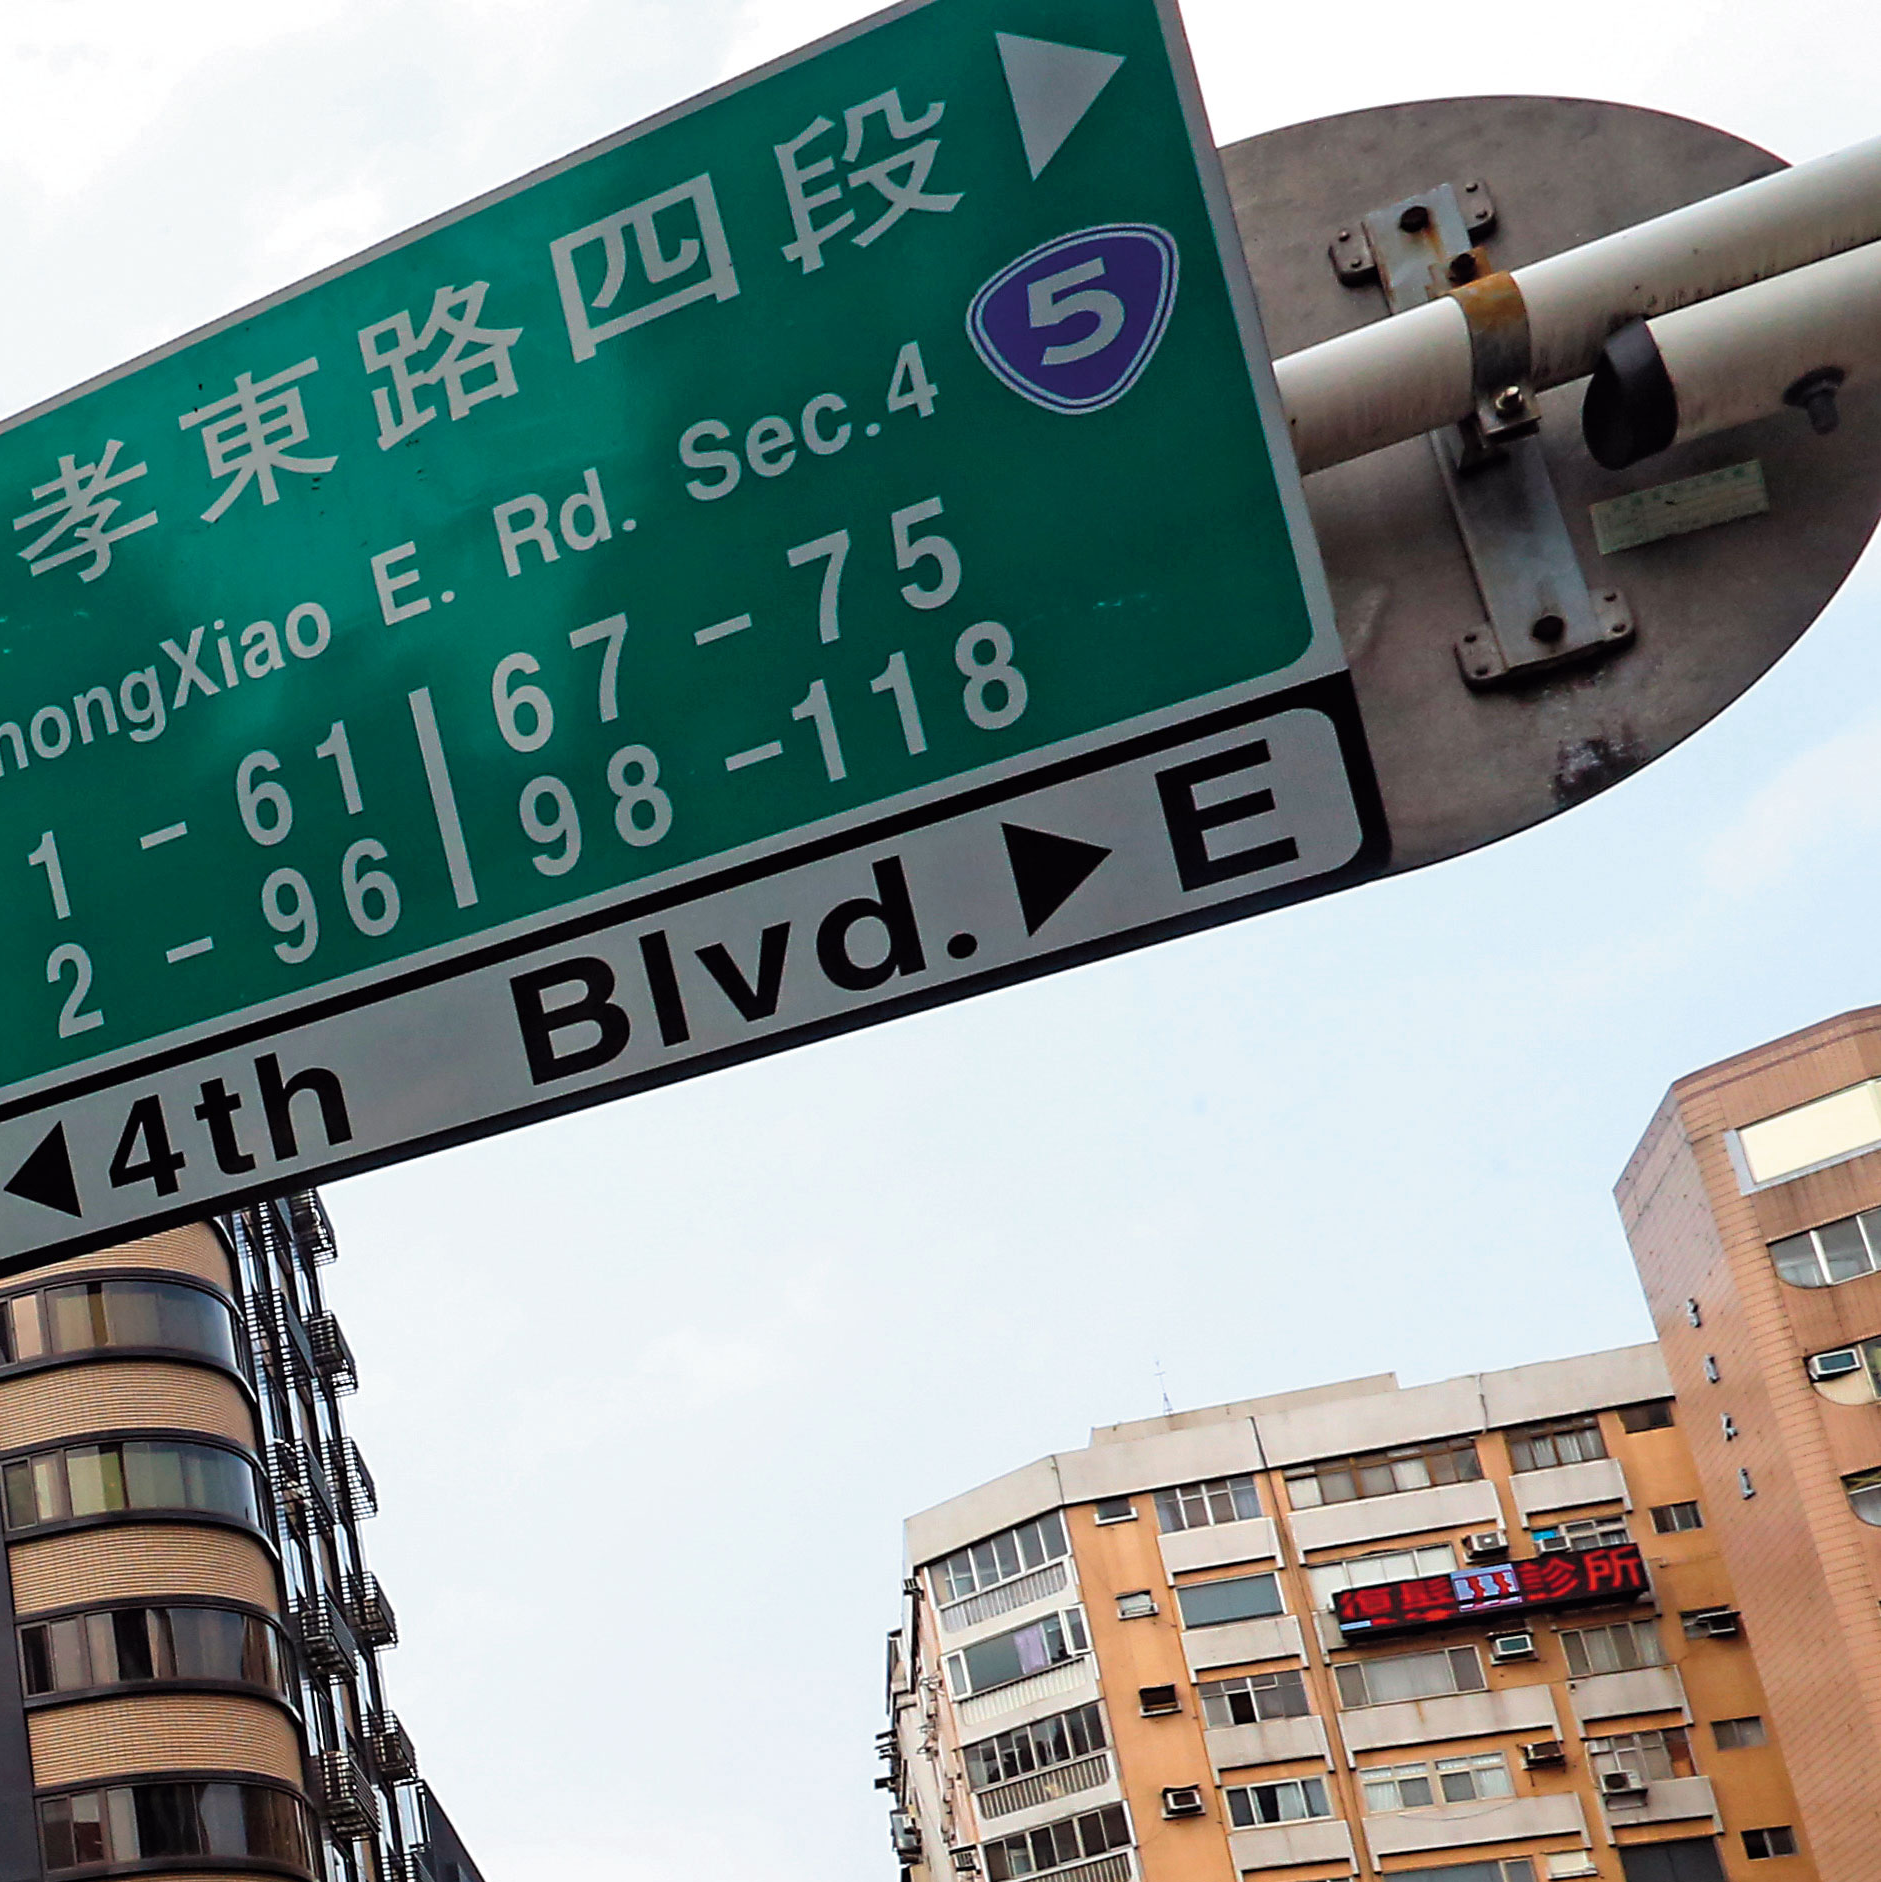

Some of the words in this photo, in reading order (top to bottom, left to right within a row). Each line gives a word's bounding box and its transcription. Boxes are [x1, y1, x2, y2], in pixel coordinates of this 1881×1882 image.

[1027, 257, 1126, 366] 5
[370, 540, 457, 627] E.
[492, 468, 639, 577] Rd.
[236, 720, 368, 847] 61
[261, 838, 403, 965] 96
[107, 1052, 354, 1198] 4th
[508, 853, 978, 1088] Blvd.
[1154, 738, 1300, 893] E
